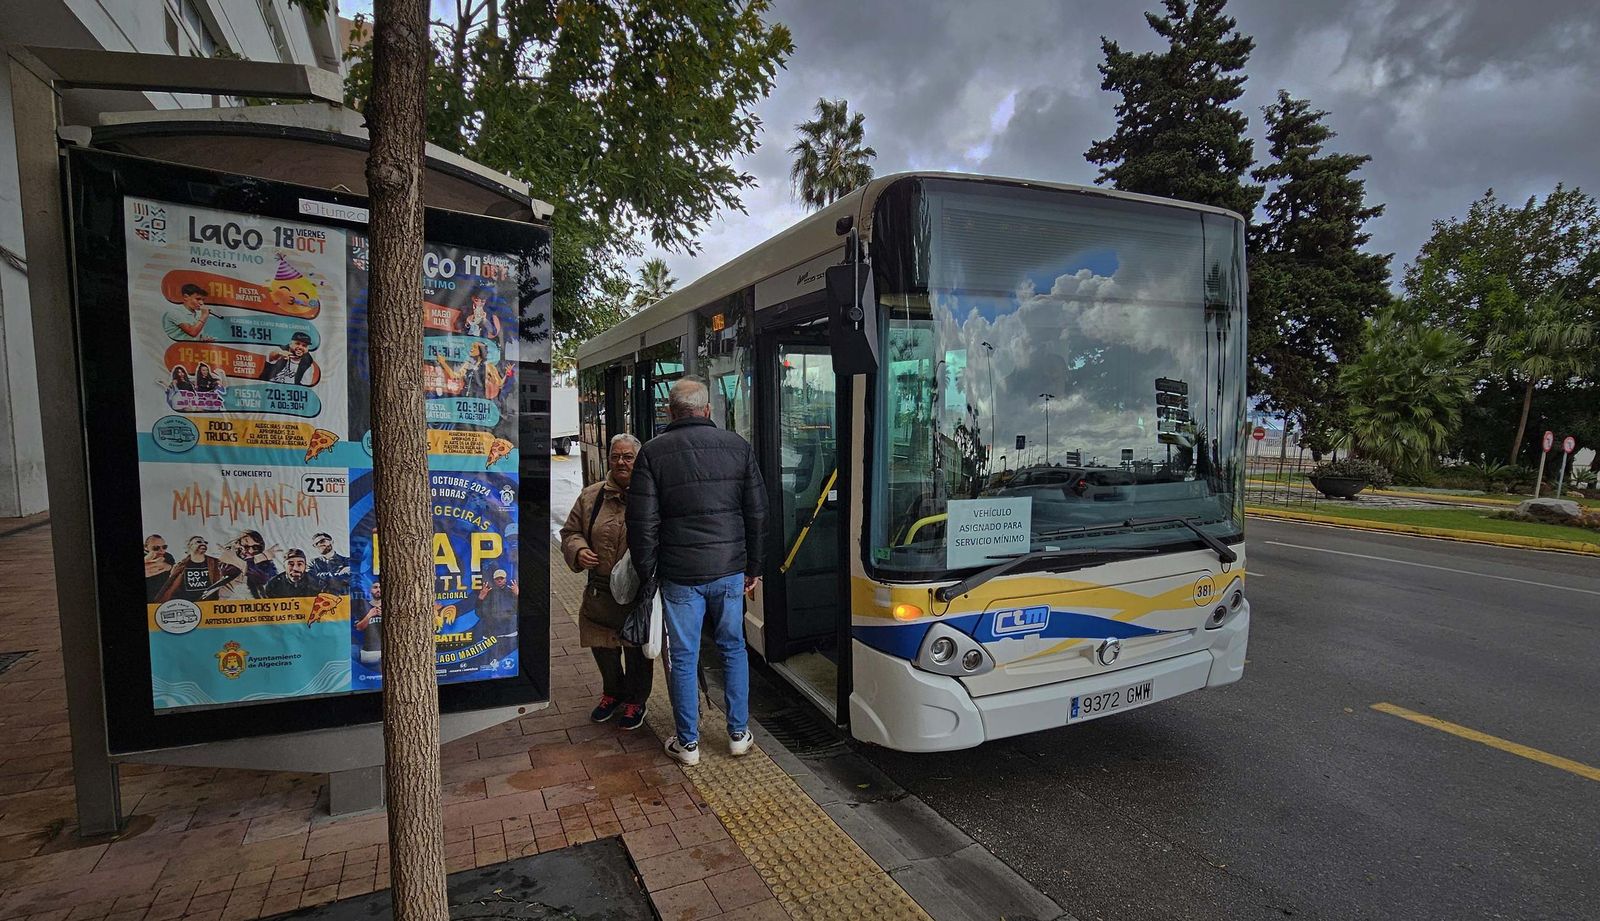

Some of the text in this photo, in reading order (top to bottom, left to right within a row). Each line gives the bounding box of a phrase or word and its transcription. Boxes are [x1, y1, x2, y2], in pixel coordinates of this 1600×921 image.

[272, 226, 294, 249] 18
[295, 228, 326, 240] VIERNES
[296, 237, 326, 254] OCT
[190, 257, 237, 269] Algeciras
[463, 255, 480, 276] 19
[208, 282, 234, 298] 17H
[239, 287, 259, 296] FIESTA
[235, 294, 262, 303] INFANTIL
[431, 309, 451, 319] MAGO
[230, 325, 272, 341] 18:45H
[235, 389, 262, 399] FIESTA
[265, 388, 308, 403] 20:30H
[235, 398, 261, 409] JOVEN
[278, 402, 304, 410] 00:30H
[456, 401, 490, 413] 20:30H
[209, 421, 233, 431] FOOD
[205, 432, 237, 442] TRUCKS
[233, 470, 272, 478] CONCIERTO
[304, 478, 324, 492] 25
[325, 483, 346, 493] OCT
[432, 476, 491, 497] OCTUBRE 2024
[439, 488, 466, 500] HORAS
[173, 478, 318, 526] MALAMANERA
[974, 508, 1012, 518] VEHÍCULO
[959, 521, 1022, 532] ASIGNADO PARA
[956, 534, 1024, 547] SERVICIO MÍNIMO
[1197, 585, 1212, 598] 381
[214, 604, 237, 614] FOOD
[240, 604, 271, 613] TRUCKS
[435, 632, 473, 643] BATTLE
[459, 636, 497, 660] MARÍTIMO
[248, 653, 302, 663] Ayuntamiento
[258, 660, 292, 669] Algeciras
[1084, 692, 1120, 713] 9372
[1127, 683, 1150, 704] GMW
